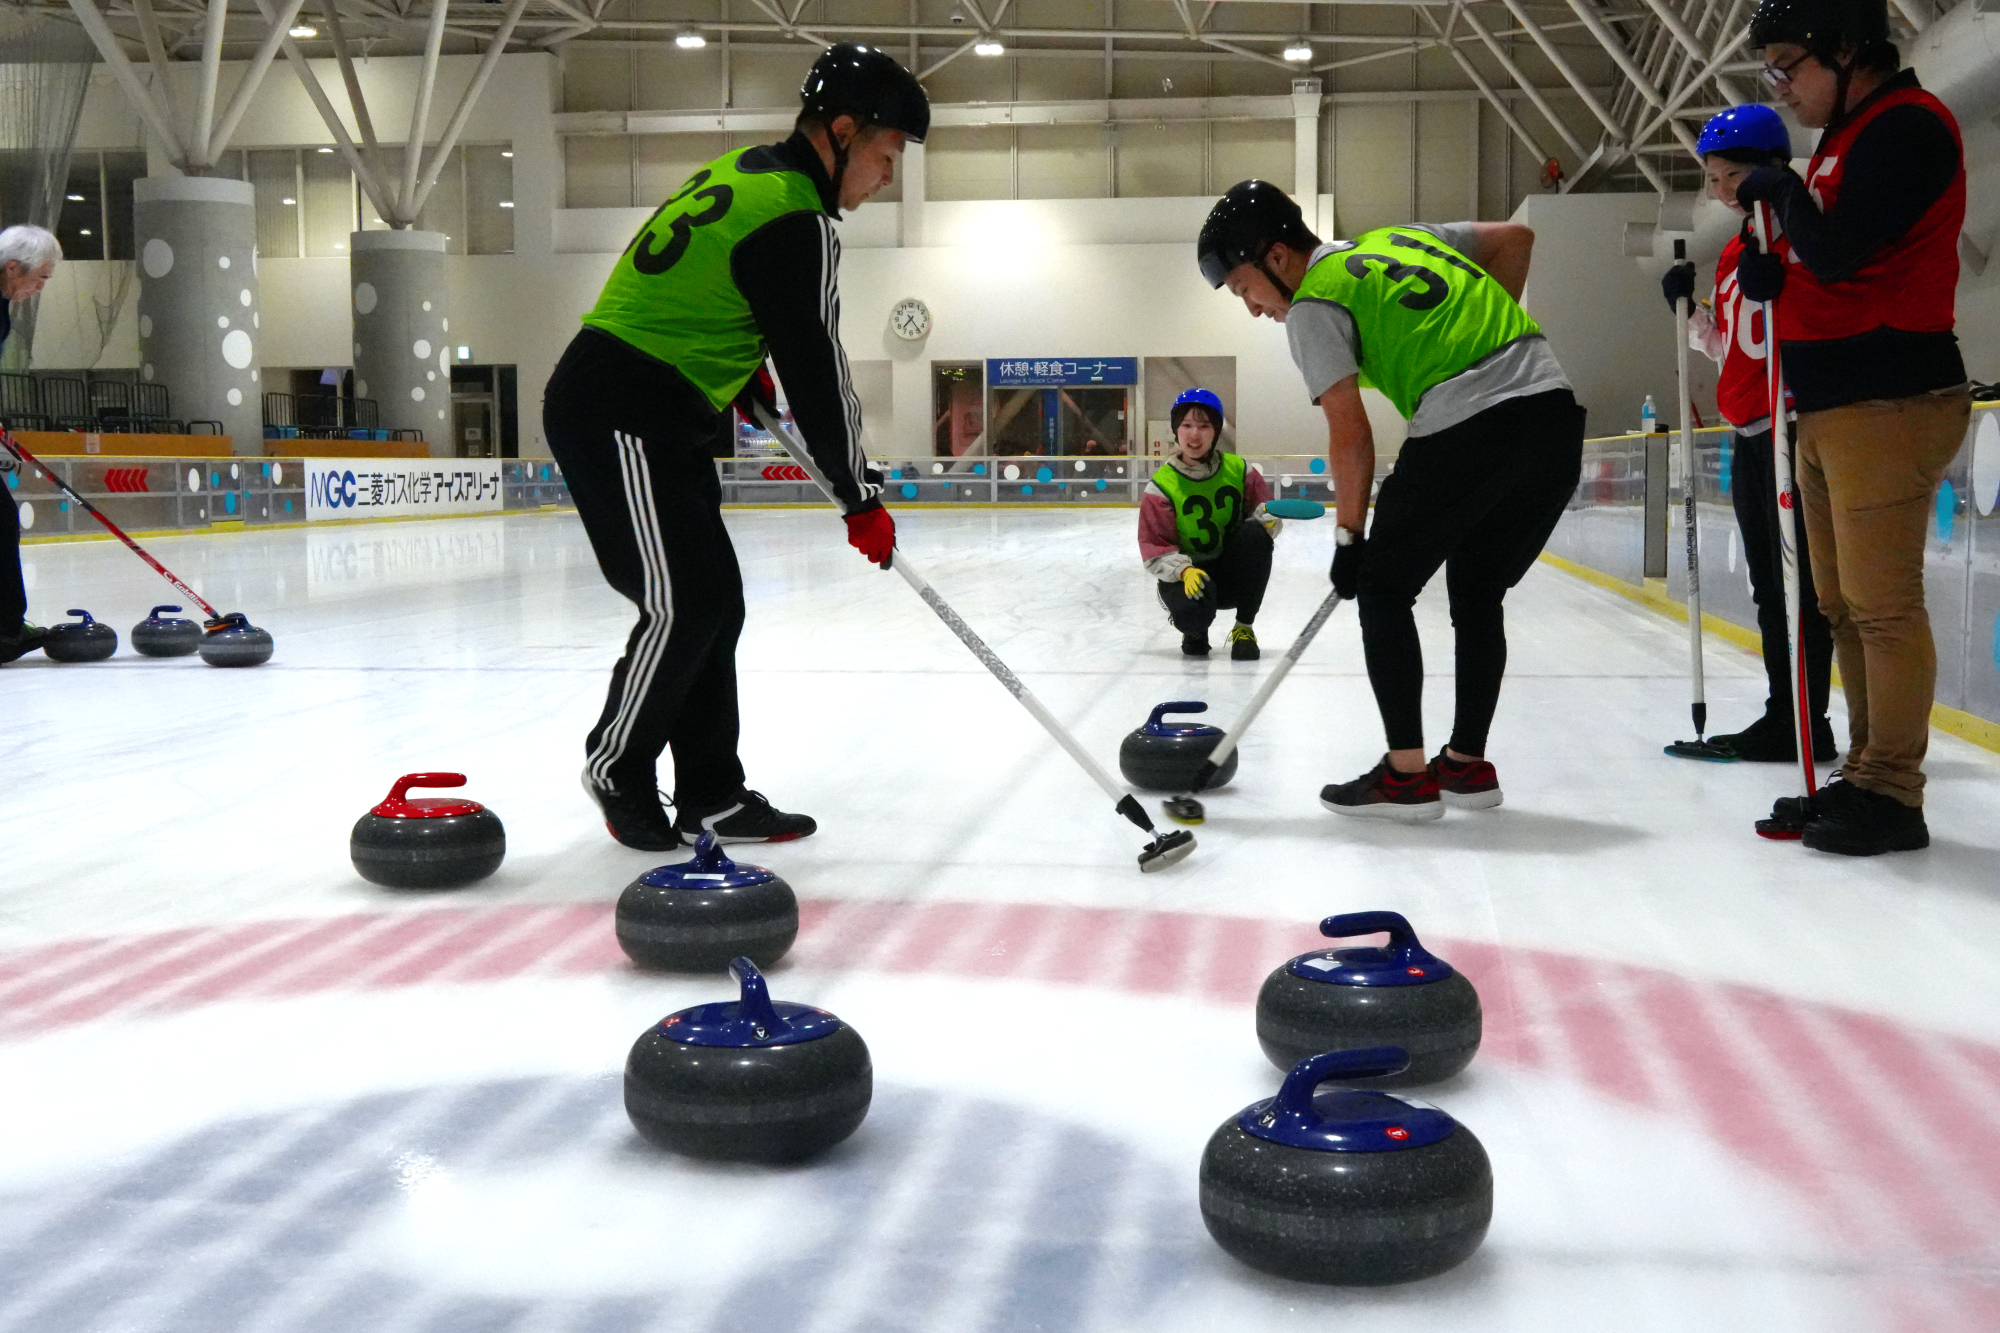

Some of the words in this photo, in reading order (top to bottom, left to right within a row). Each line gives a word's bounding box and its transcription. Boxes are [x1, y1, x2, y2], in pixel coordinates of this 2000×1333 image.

[1345, 232, 1487, 311] 31
[311, 470, 356, 508] MGC
[357, 471, 432, 506] 三菱ガス化学
[433, 471, 500, 502] アイスアリーナ
[173, 580, 207, 611] Goldline
